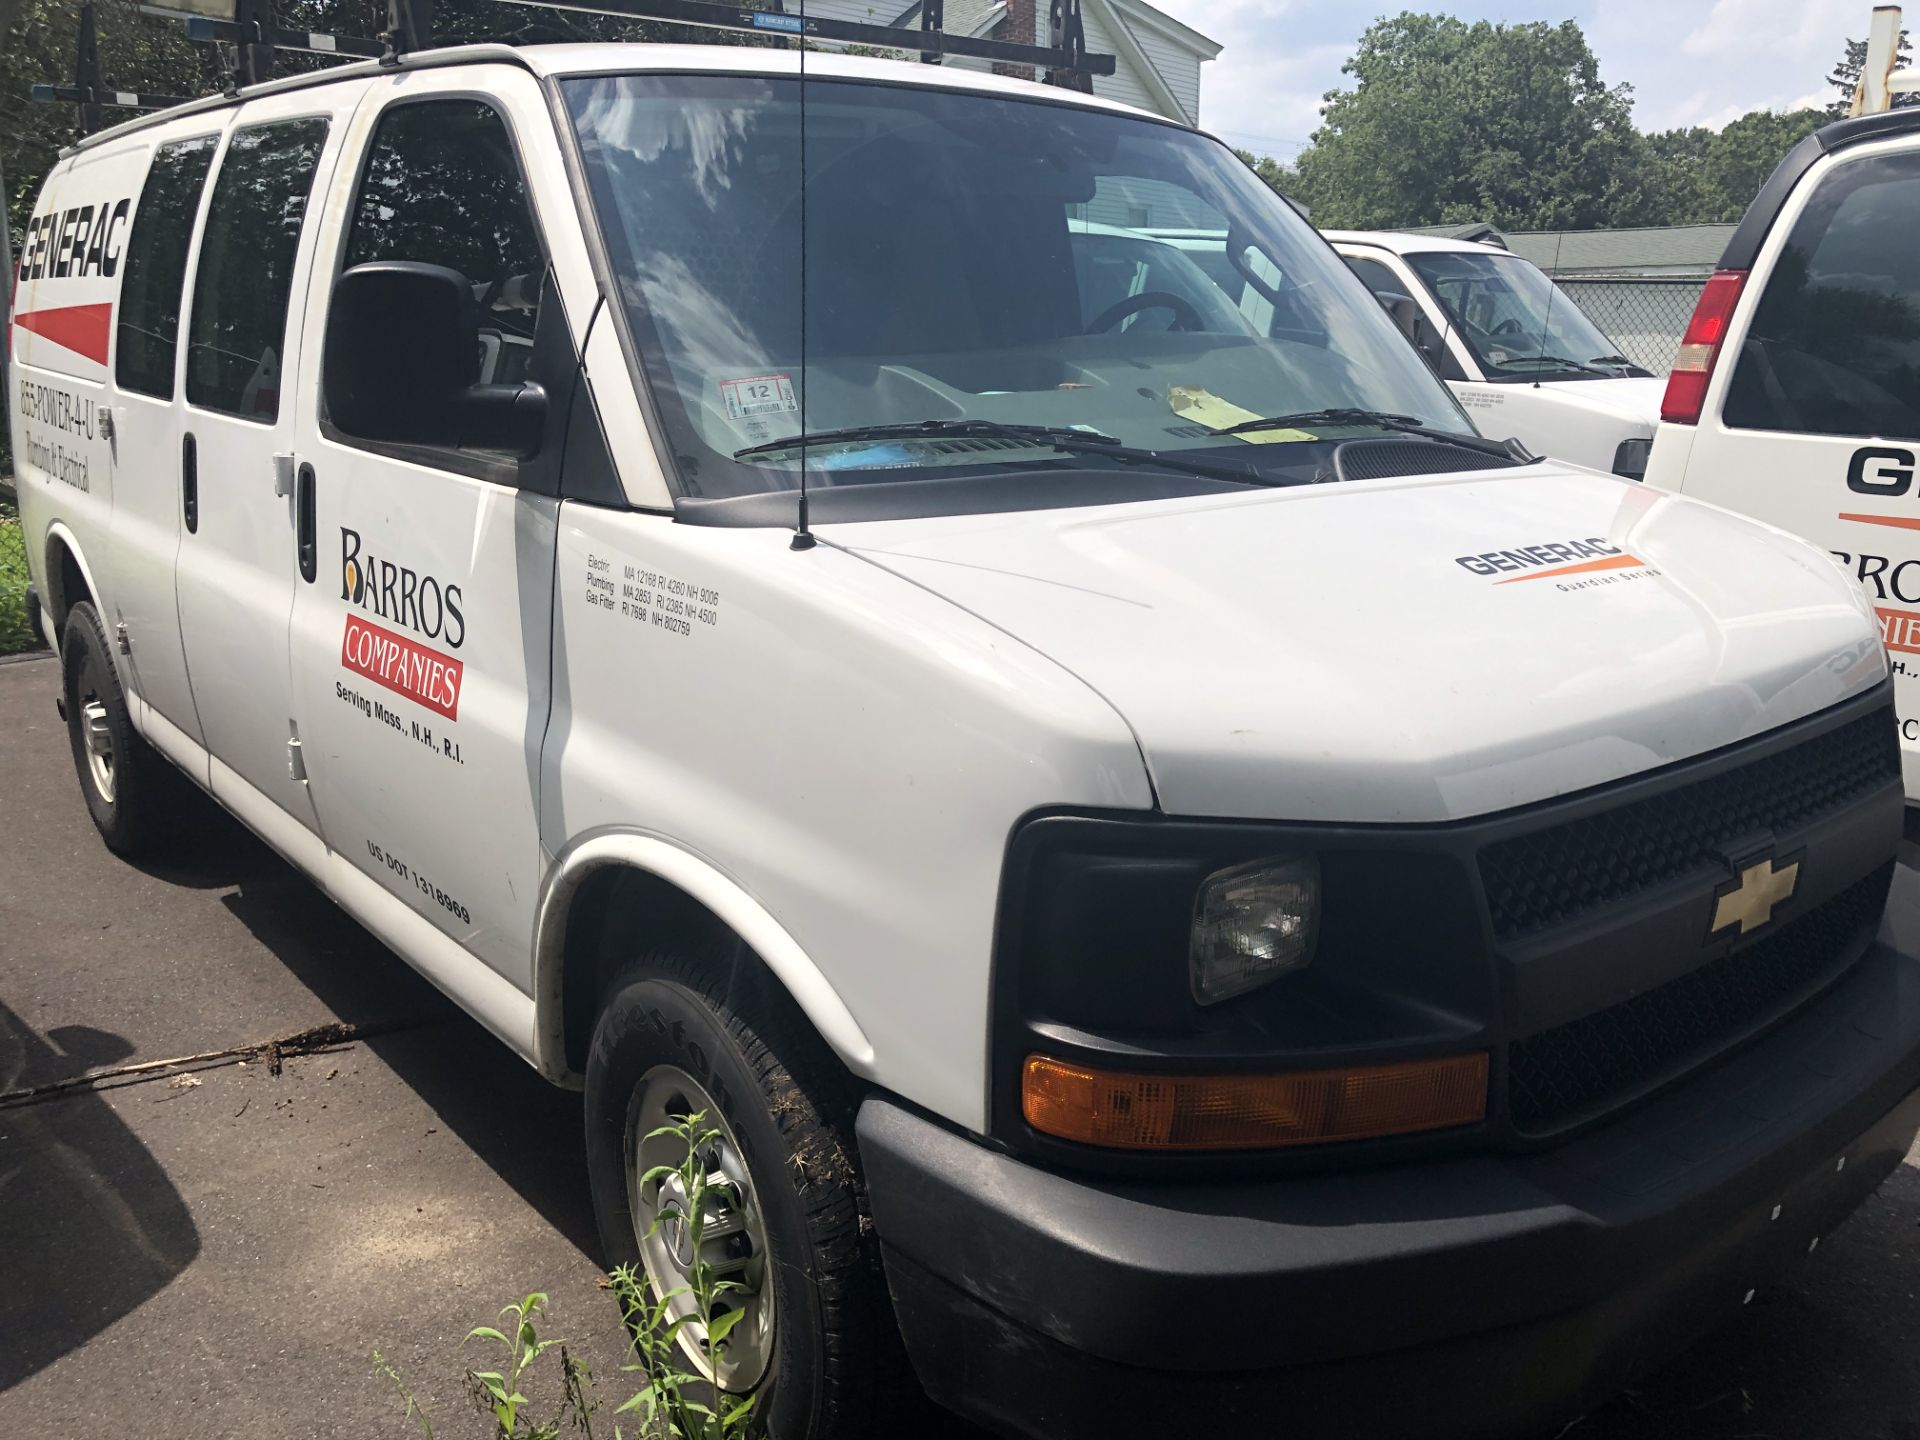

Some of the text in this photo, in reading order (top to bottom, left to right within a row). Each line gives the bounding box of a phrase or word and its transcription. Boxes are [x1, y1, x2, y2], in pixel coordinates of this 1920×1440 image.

[20, 198, 131, 282] GENERAC
[21, 380, 94, 440] 855-POWER-4-U
[747, 385, 770, 399] 12
[58, 445, 90, 494] Electrical
[1847, 446, 1920, 498] G
[1455, 537, 1622, 576] GENERAC
[1556, 569, 1661, 592] Guardian Series
[340, 526, 465, 649] BARROS
[587, 572, 717, 626] Plumbing MA 2853 RI 2385 NH 4500
[624, 565, 635, 581] MA
[636, 569, 657, 588] 12168
[658, 575, 666, 590] RI
[667, 579, 685, 596] 4260
[686, 584, 698, 600] NH
[700, 588, 719, 606] 9006
[586, 589, 598, 605] Gas
[622, 601, 629, 616] RI
[652, 611, 663, 628] NH
[664, 615, 691, 636] 802759
[346, 625, 457, 709] COMPANIES
[336, 681, 464, 764] Serving Mass., N.H., R.I.
[367, 840, 470, 925] US DOT 1318969
